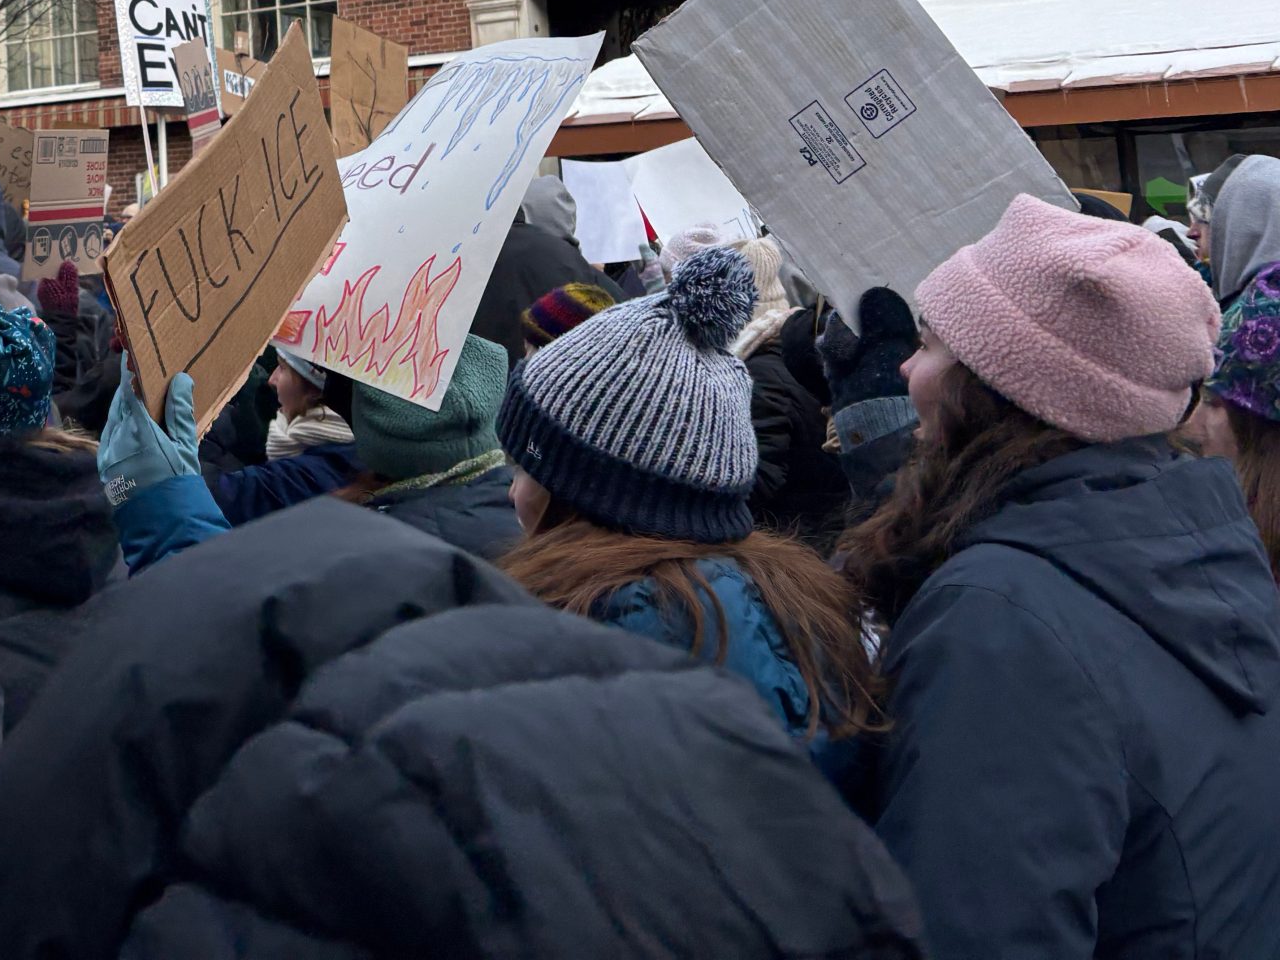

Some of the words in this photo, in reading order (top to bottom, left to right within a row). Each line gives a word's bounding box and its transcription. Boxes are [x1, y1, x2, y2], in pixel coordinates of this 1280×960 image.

[864, 87, 894, 122] Corrugated
[874, 84, 899, 115] Recycles
[85, 161, 106, 171] STORE
[129, 173, 255, 379] FUCK
[260, 89, 320, 222] ICE
